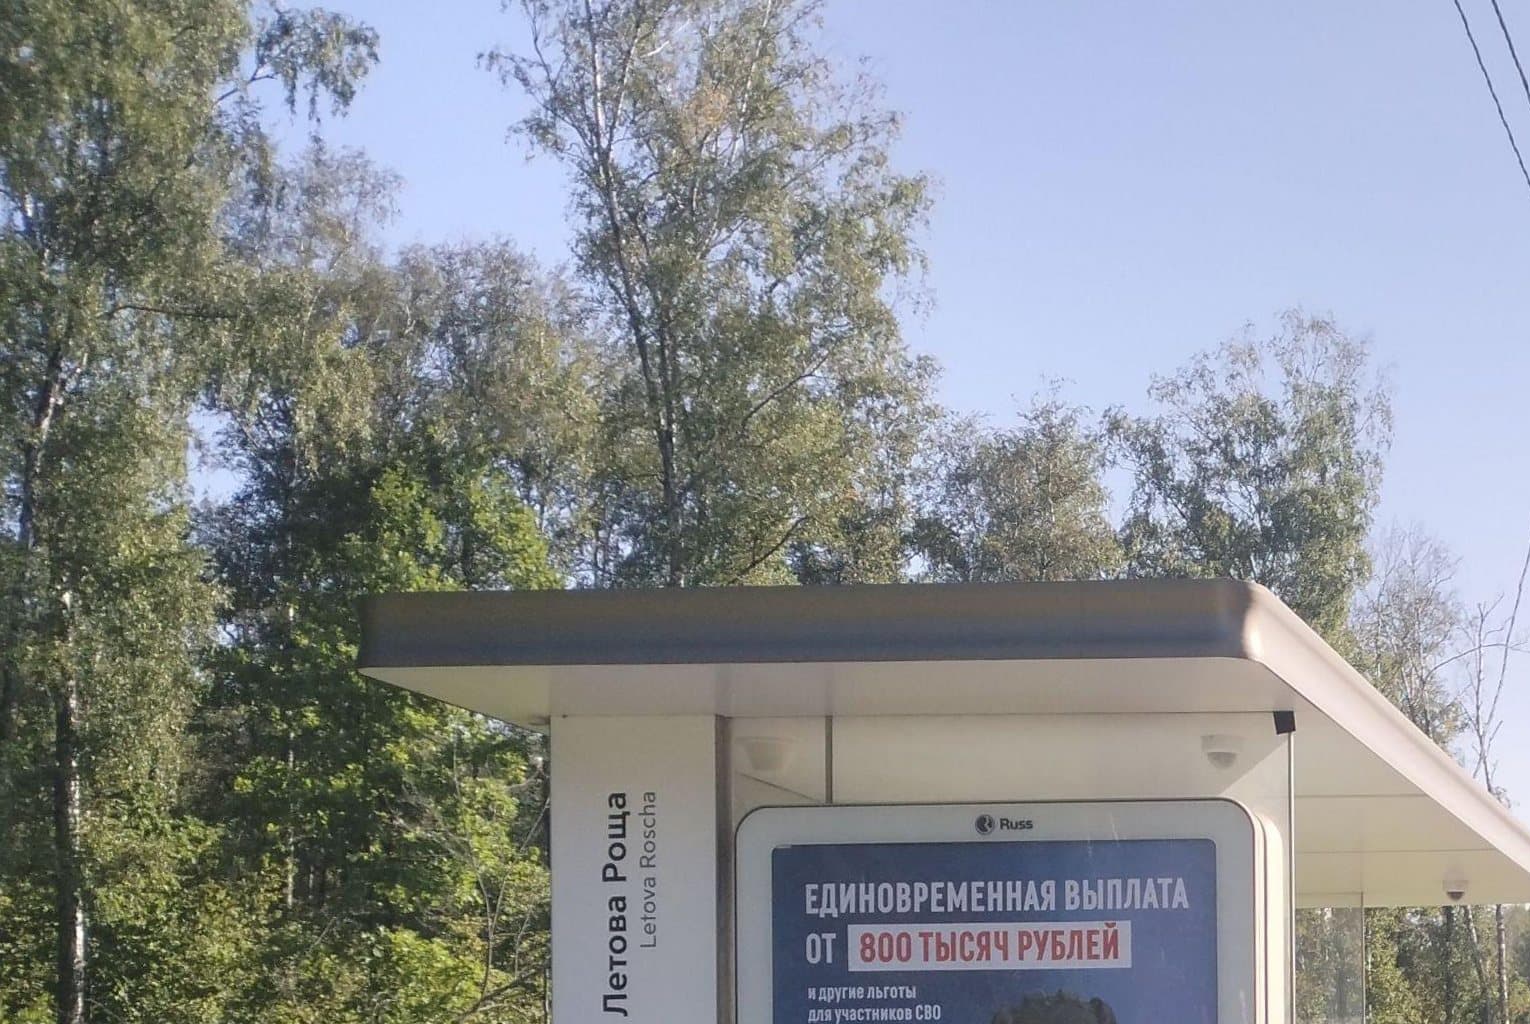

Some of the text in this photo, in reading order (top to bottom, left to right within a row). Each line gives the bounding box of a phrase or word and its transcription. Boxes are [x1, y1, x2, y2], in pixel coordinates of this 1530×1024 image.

[1000, 818, 1033, 831] Russ
[638, 791, 656, 948] Letova Roscha
[602, 791, 630, 1017] Летова Роща
[805, 877, 1189, 917] ЕДИНОВРЕМЕННАЯ ВЫПЛАТА
[806, 922, 1120, 964] ОТ 800 ТЫСЯЧ РУБЛЕЙ
[808, 986, 917, 1003] и другие льготы
[808, 1004, 941, 1024] для участников СВО
